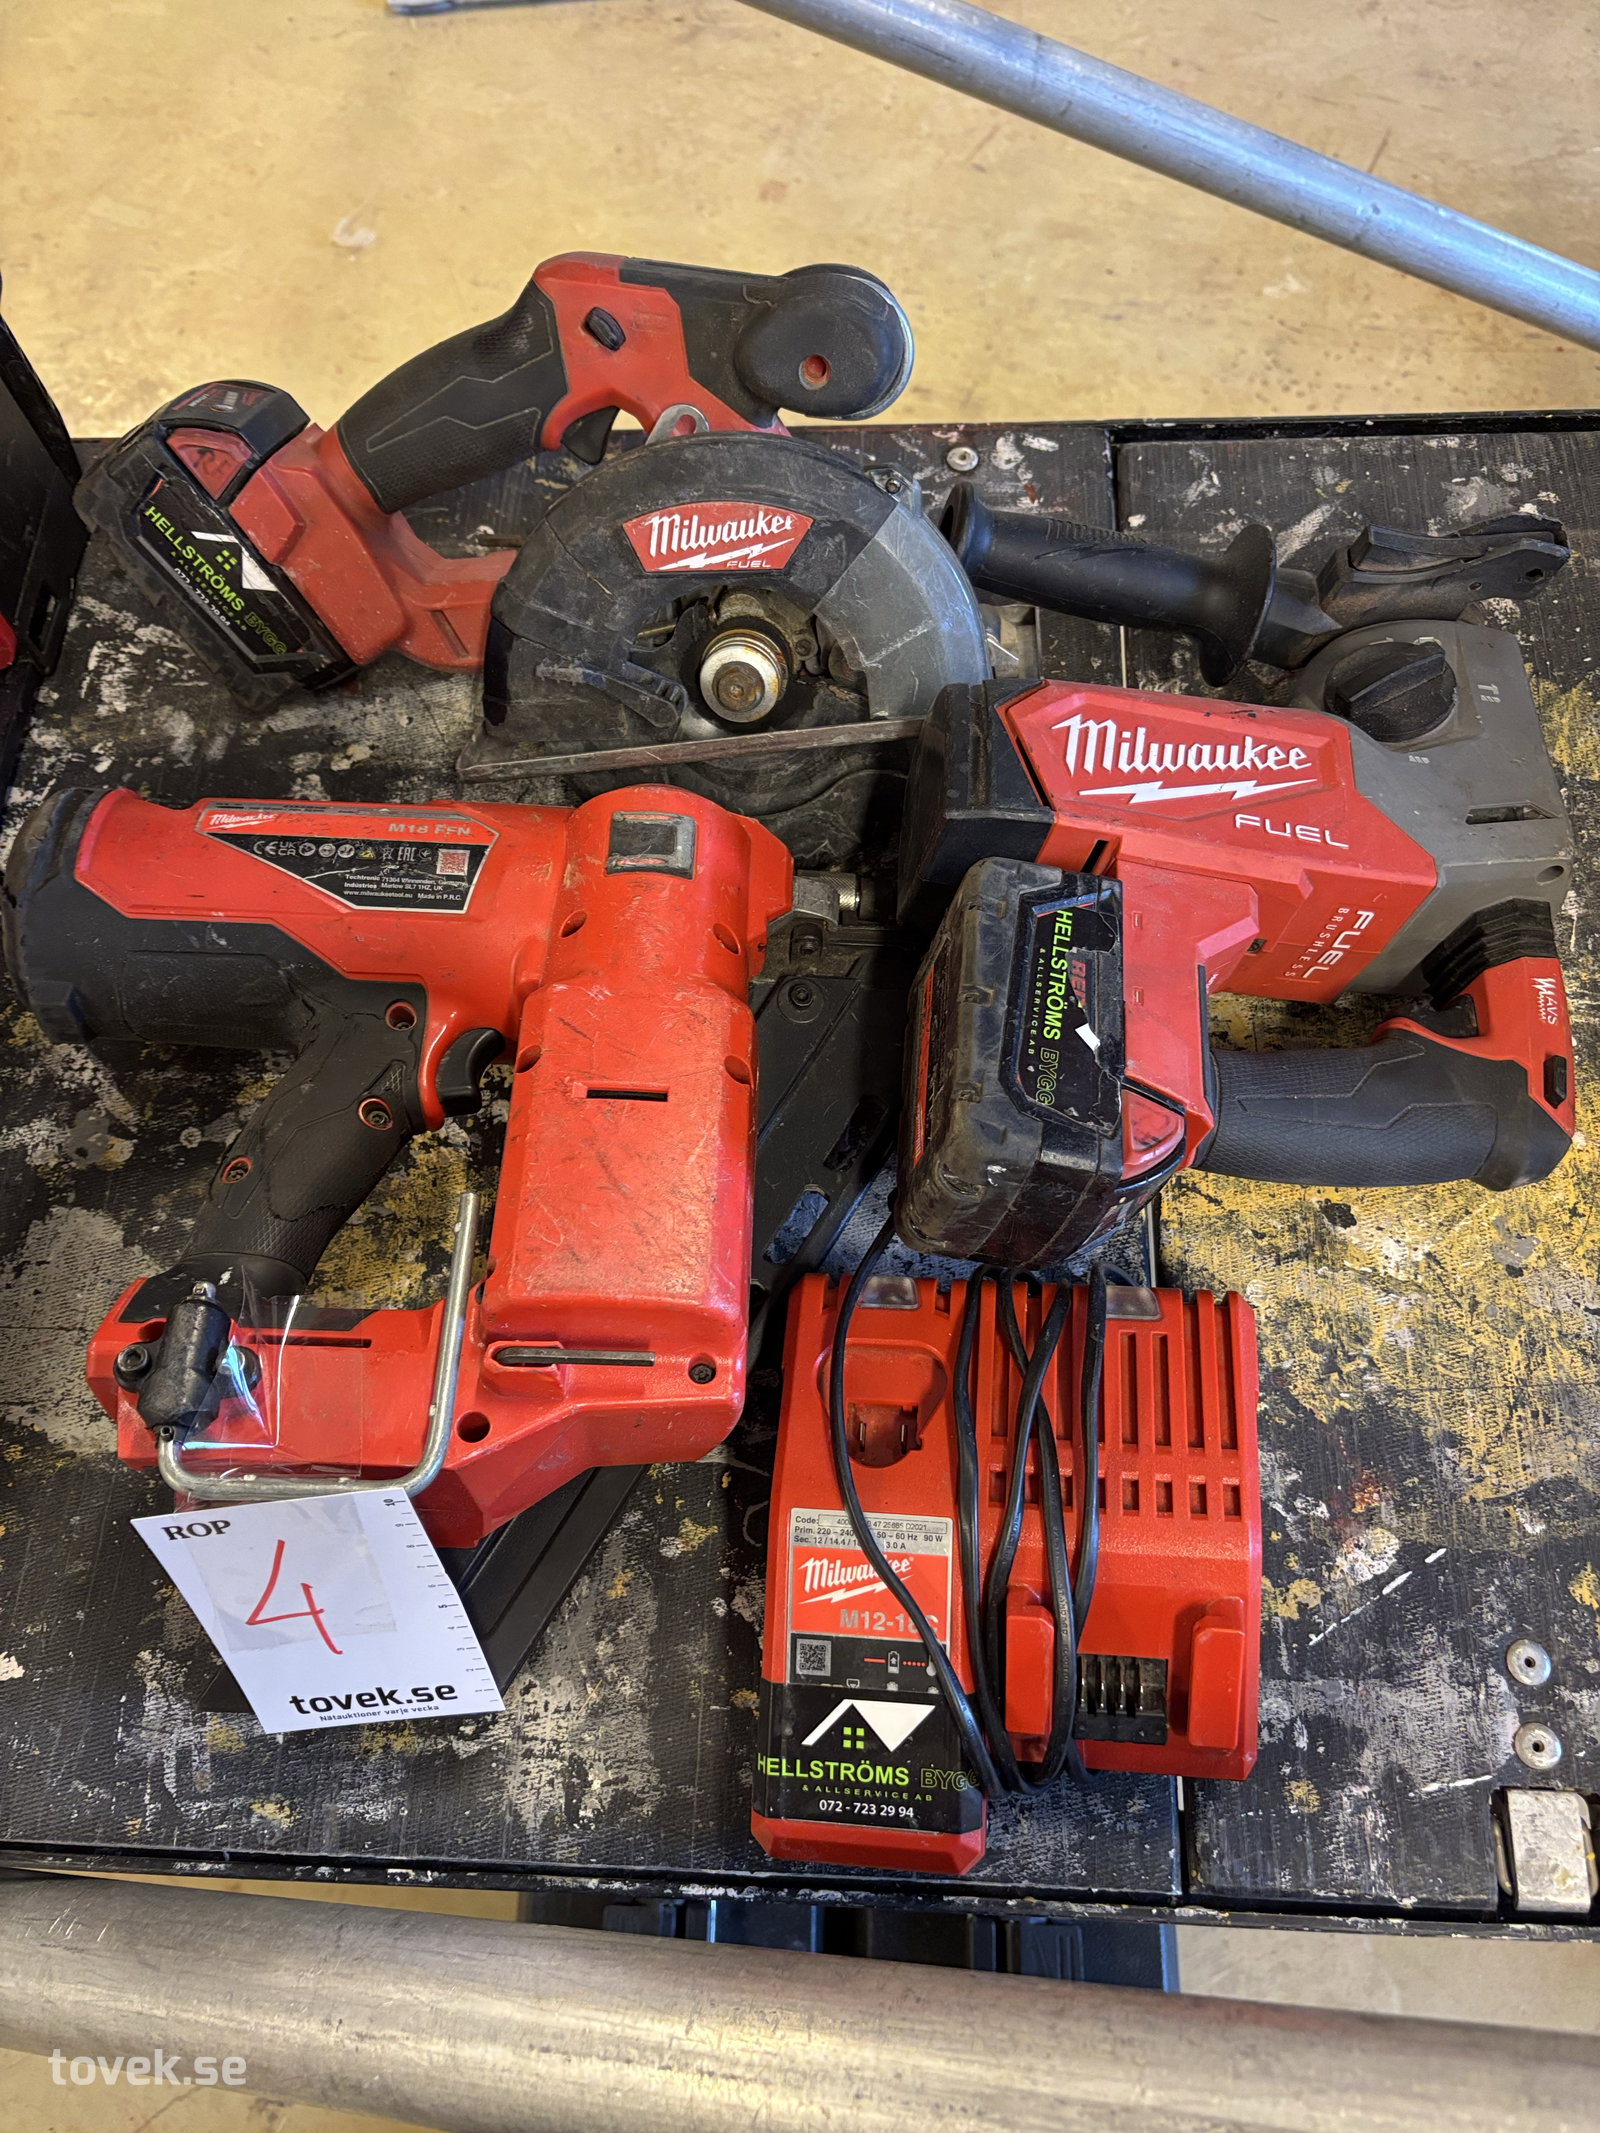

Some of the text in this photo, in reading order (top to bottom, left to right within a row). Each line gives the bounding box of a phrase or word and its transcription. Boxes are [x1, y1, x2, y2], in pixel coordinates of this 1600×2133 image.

[726, 559, 773, 569] FUEL
[143, 505, 288, 656] HELLSTRÖMS BYGG
[1051, 713, 1313, 778] Milwaukee
[208, 813, 278, 825] Milwaukee
[388, 823, 429, 835] M18
[1234, 813, 1350, 850] FUEL
[344, 882, 378, 890] Industries
[380, 882, 404, 890] Marlow
[345, 874, 381, 882] Techtronic
[343, 890, 414, 899] www.milwaukeetool.eu
[417, 892, 435, 900] Made
[1284, 906, 1350, 978] BRUSHLESS
[1302, 910, 1375, 980] FUEL
[1030, 957, 1044, 1036] ALLSERVICE
[1035, 909, 1074, 1106] HELLSTRÖMS BYGG
[1028, 1039, 1036, 1056] AB
[161, 1519, 232, 1541] ROP
[795, 1515, 819, 1525] Code:
[872, 1521, 882, 1529] 47
[793, 1535, 812, 1543] Sec.
[813, 1537, 823, 1545] 12
[829, 1537, 846, 1546] 14.4
[886, 1541, 899, 1549] 3.0
[794, 1526, 815, 1534] Prim.
[817, 1527, 832, 1535] 220
[839, 1528, 855, 1536] 240
[876, 1531, 887, 1539] 50
[895, 1532, 906, 1540] 60
[907, 1533, 918, 1541] Hz
[923, 1534, 934, 1542] 90
[934, 1535, 944, 1543] W
[244, 1539, 345, 1656] 4
[289, 1682, 459, 1716] tovek.se
[383, 1706, 409, 1716] varje
[411, 1704, 440, 1713] vecka
[756, 1751, 982, 1792] HELLSTRÖMS BYGG
[801, 1783, 933, 1802] & ALLSERVICE AB
[818, 1799, 843, 1813] 072
[852, 1801, 877, 1815] 723
[880, 1804, 896, 1817] 29
[898, 1805, 915, 1818] 94
